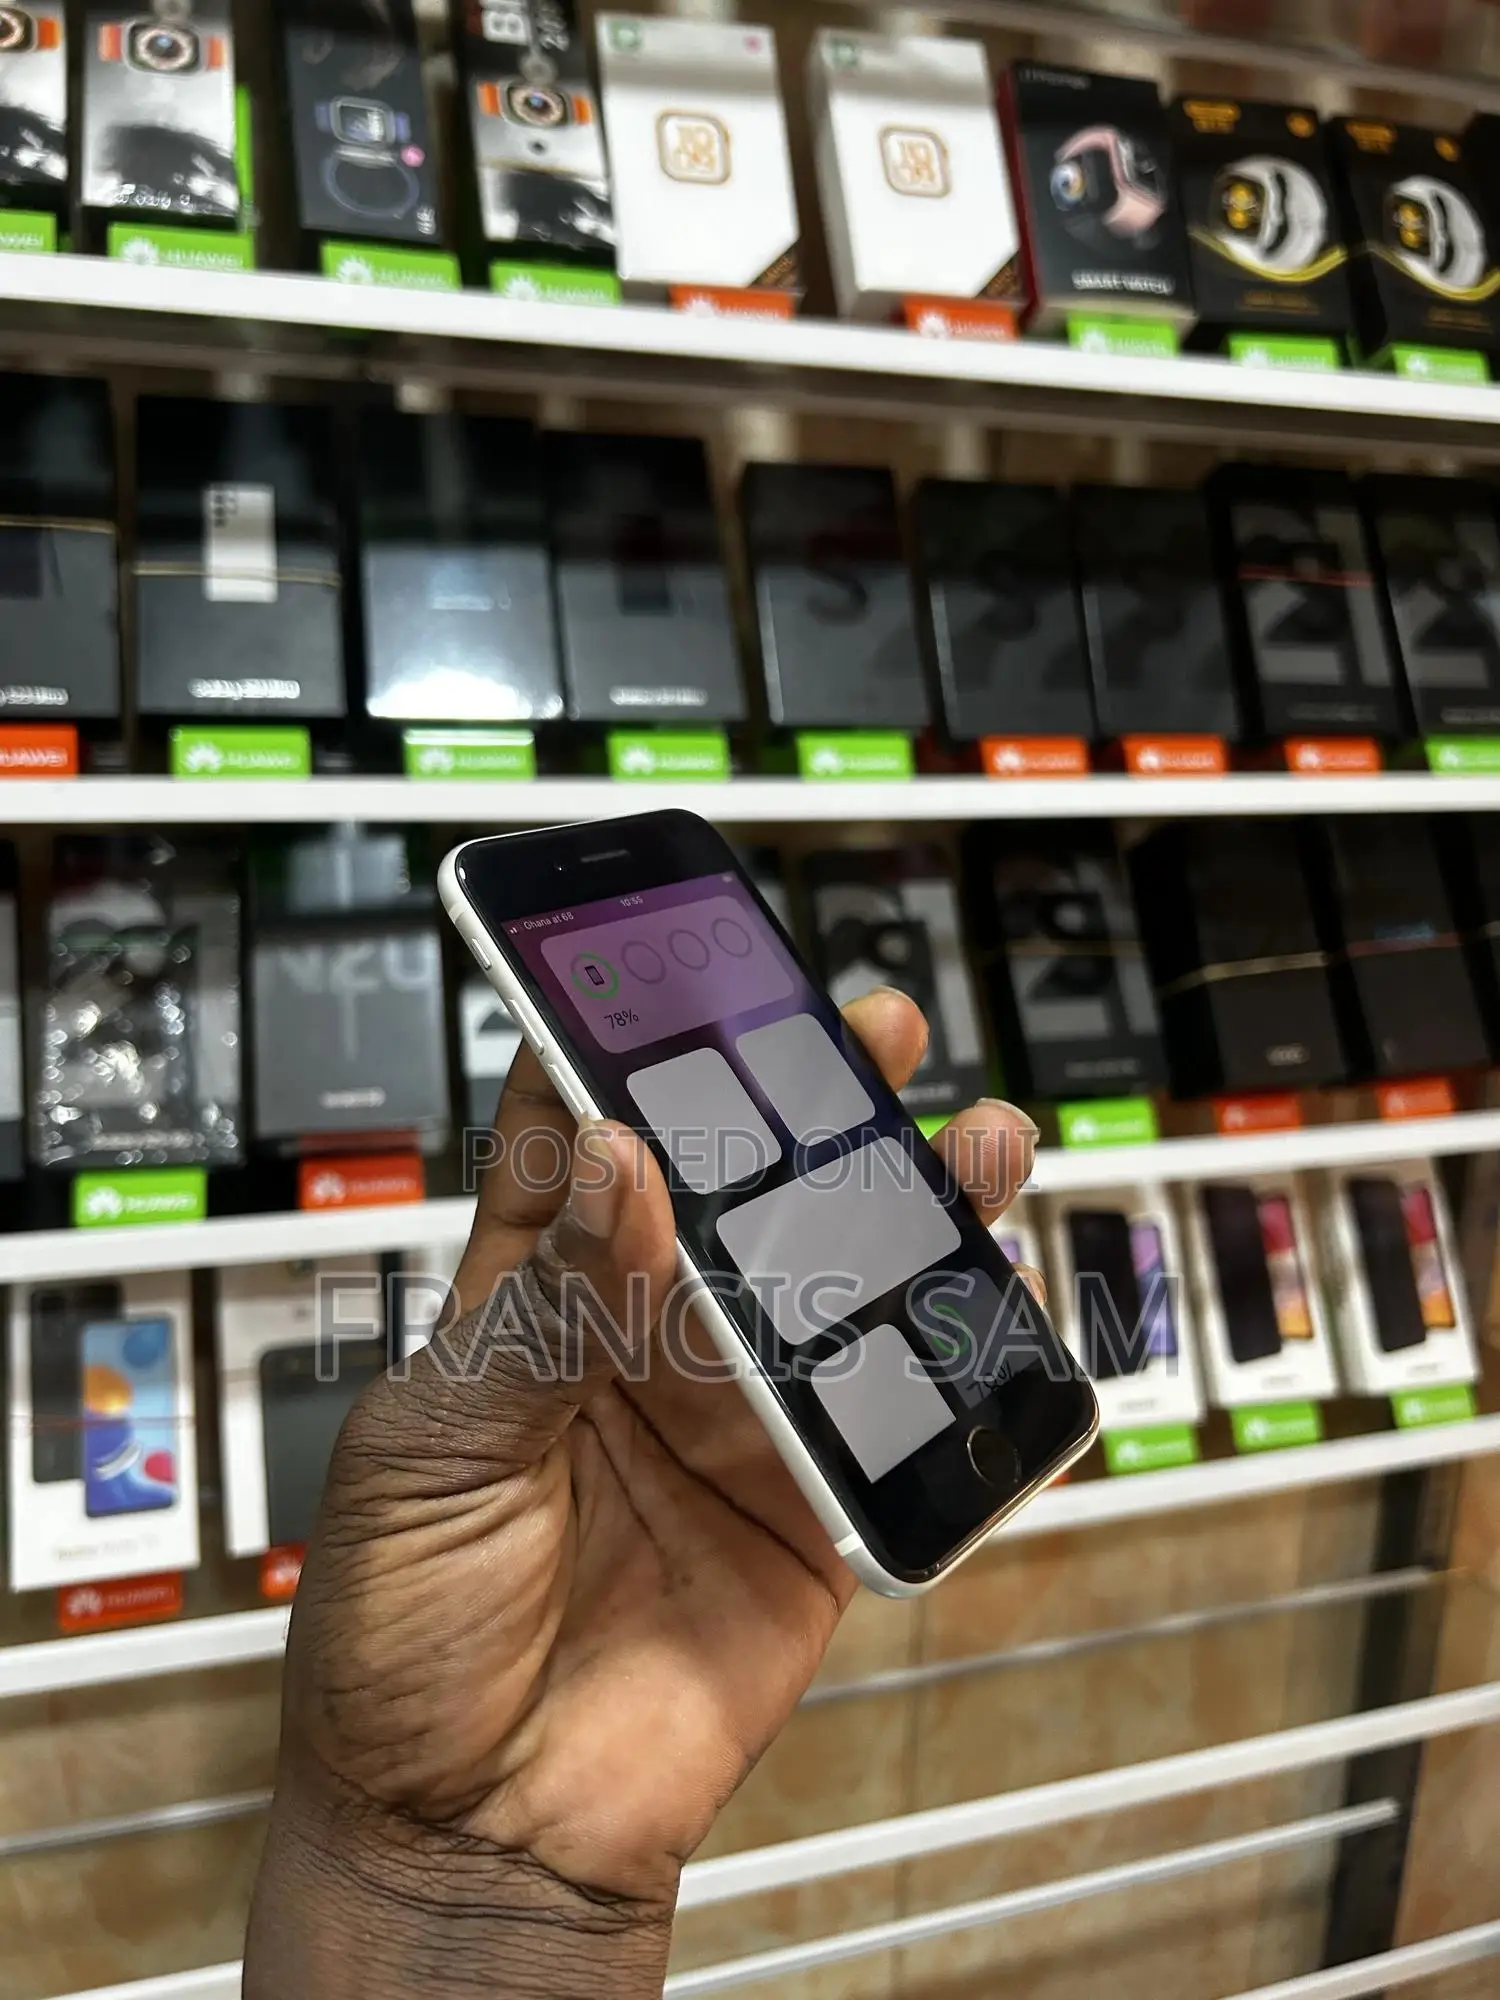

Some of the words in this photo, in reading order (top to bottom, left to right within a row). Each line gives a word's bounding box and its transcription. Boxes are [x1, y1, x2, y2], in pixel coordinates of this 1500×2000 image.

[524, 917, 552, 930] Ghana
[552, 912, 562, 924] at
[603, 1008, 639, 1030] 78%
